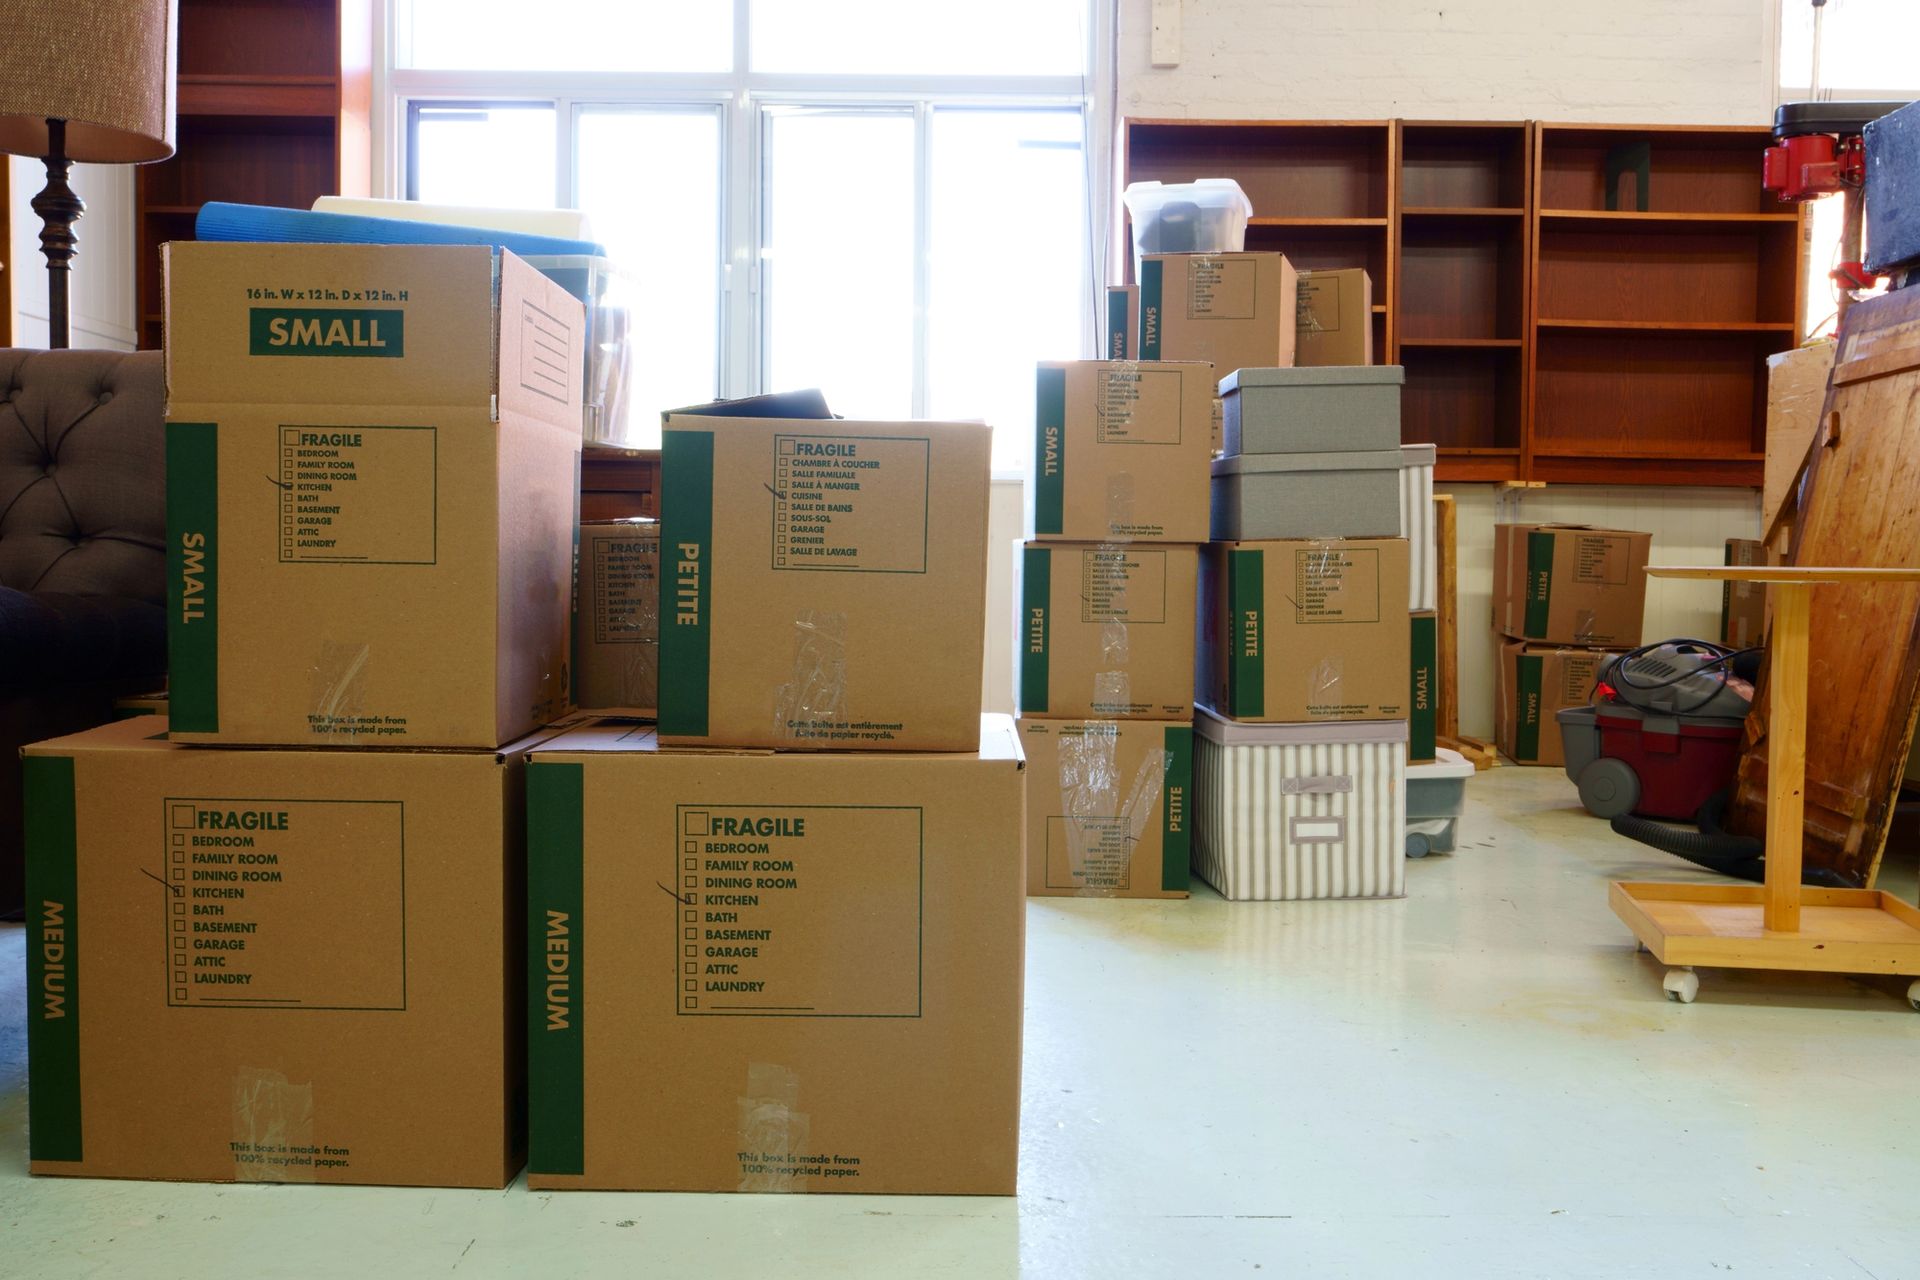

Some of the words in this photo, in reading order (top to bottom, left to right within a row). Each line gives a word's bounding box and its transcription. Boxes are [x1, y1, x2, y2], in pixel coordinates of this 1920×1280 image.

[247, 288, 261, 299] 16
[264, 288, 278, 300] in.
[281, 289, 293, 299] W
[297, 292, 304, 300] x
[308, 289, 322, 300] 12
[325, 290, 338, 300] in.
[342, 290, 350, 300] D
[366, 291, 379, 301] 12
[382, 291, 395, 301] in.
[400, 291, 408, 301] H
[1146, 307, 1156, 346] SMALL
[268, 318, 386, 347] SMALL
[1114, 332, 1123, 359] SMA
[301, 434, 362, 447] FRAGILE
[796, 443, 856, 457] FRAGILE
[1046, 427, 1058, 476] SMALL
[833, 459, 839, 468] À
[842, 461, 880, 469] COUCHER
[816, 471, 856, 479] FAMILIALE
[816, 481, 822, 489] À
[297, 506, 340, 514] BASEMENT
[297, 517, 332, 525] GARAGE
[183, 533, 205, 624] SMALL
[677, 544, 699, 625] PETITE
[1538, 571, 1548, 600] PETITE
[1032, 608, 1043, 652] PETITE
[1246, 611, 1257, 656] PETITE
[1417, 667, 1427, 709] SMALL
[1528, 693, 1536, 725] SMALL
[308, 715, 325, 723] This
[357, 716, 382, 724] made
[385, 716, 406, 724] from
[339, 725, 375, 735] recycled
[378, 727, 406, 735] paper.
[831, 731, 859, 739] papier
[1170, 787, 1182, 832] PETITE
[198, 811, 289, 830] FRAGILE
[711, 817, 804, 837] FRAGILE
[192, 836, 254, 847] BEDROOM
[705, 843, 769, 854] BEDROOM
[192, 854, 234, 864] FAMILY
[238, 854, 278, 864] ROOM
[705, 861, 749, 871] FAMILY
[753, 861, 794, 871] ROOM
[192, 871, 238, 881] DINING
[242, 872, 282, 882] ROOM
[705, 878, 752, 888] DINING
[757, 878, 797, 889] ROOM
[192, 888, 244, 899] KITCHEN
[705, 895, 759, 905] KITCHEN
[193, 905, 224, 915] BATH
[705, 913, 737, 922] BATH
[193, 922, 257, 933] BASEMENT
[705, 930, 772, 940] BASEMENT
[194, 940, 245, 950] GARAGE
[705, 947, 758, 957] GARAGE
[44, 900, 65, 1019] MEDIUM
[194, 957, 225, 966] ATTIC
[547, 910, 568, 1030] MEDIUM
[705, 964, 738, 974] ATTIC
[194, 974, 252, 984] LAUNDRY
[705, 982, 765, 992] LAUNDRY
[230, 1142, 250, 1151] This
[255, 1143, 275, 1152] box
[278, 1144, 287, 1152] is
[290, 1145, 320, 1153] made
[323, 1145, 349, 1155] from
[235, 1154, 265, 1164] 100%
[314, 1158, 349, 1168] paper.
[737, 1152, 758, 1162] This
[763, 1152, 784, 1162] box
[788, 1153, 796, 1163] is
[800, 1155, 830, 1164] made
[833, 1155, 860, 1165] from
[743, 1164, 773, 1174] 100%
[777, 1166, 821, 1176] recycled
[824, 1168, 859, 1177] paper.
